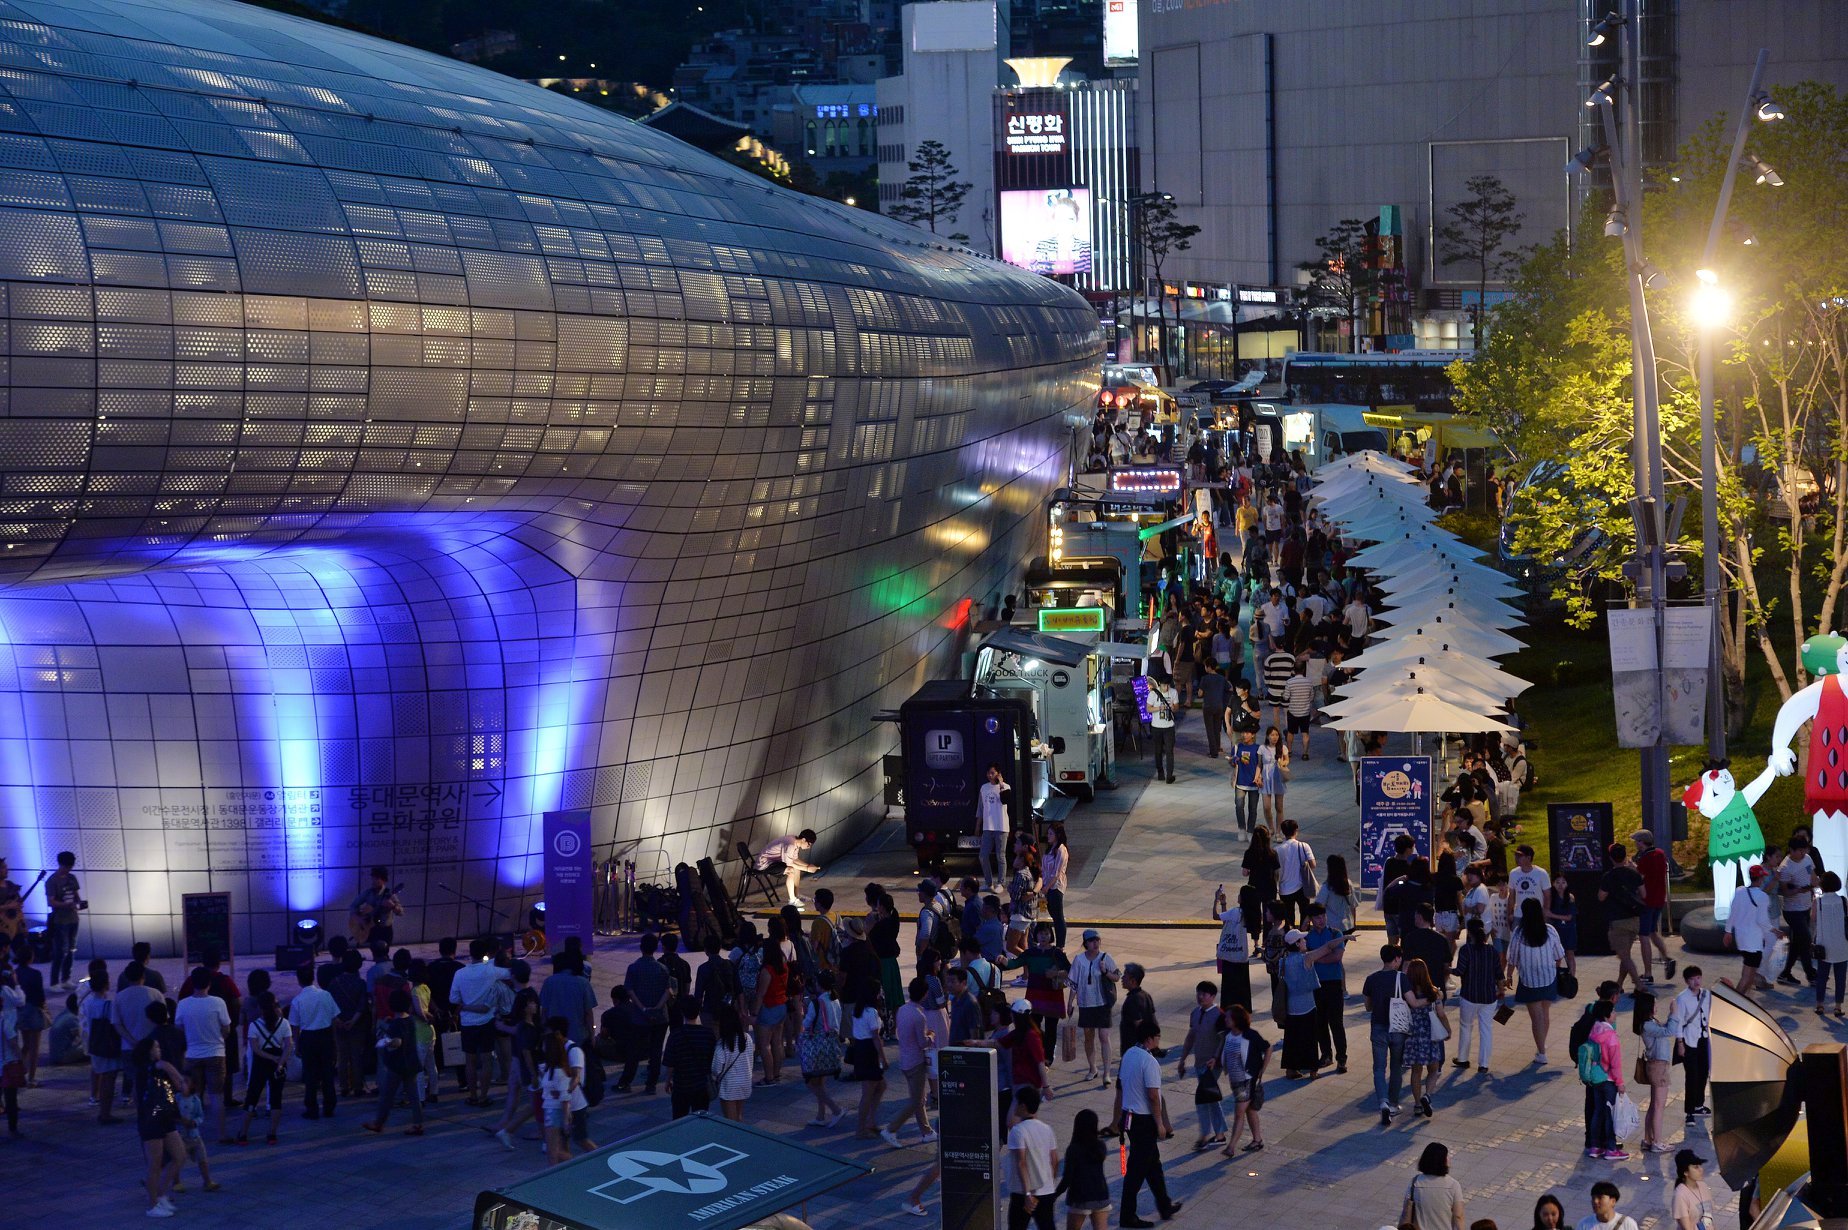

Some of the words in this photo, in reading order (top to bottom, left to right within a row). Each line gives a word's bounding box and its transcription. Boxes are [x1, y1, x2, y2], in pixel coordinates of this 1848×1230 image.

[1008, 115, 1063, 134] 신평화
[1018, 669, 1049, 677] TRUCK
[938, 734, 952, 750] LP
[276, 791, 306, 801] 알림터
[347, 783, 466, 810] 동대문역사
[142, 805, 210, 816] 이간수문전시장
[218, 804, 308, 815] 동대문운동장기념관
[162, 818, 220, 829] 동대문역사관
[221, 818, 246, 829] 1398
[254, 817, 284, 828] 갤러리
[368, 807, 461, 834] 문화공원
[346, 838, 411, 849] DONGDAEMUN
[414, 837, 451, 846] HISTORY
[395, 846, 431, 855] CULTURE
[435, 844, 457, 853] PARK
[944, 1151, 989, 1160] 동대문역사문화공원
[688, 1190, 759, 1222] AMERICAN
[750, 1174, 799, 1195] STEAK
